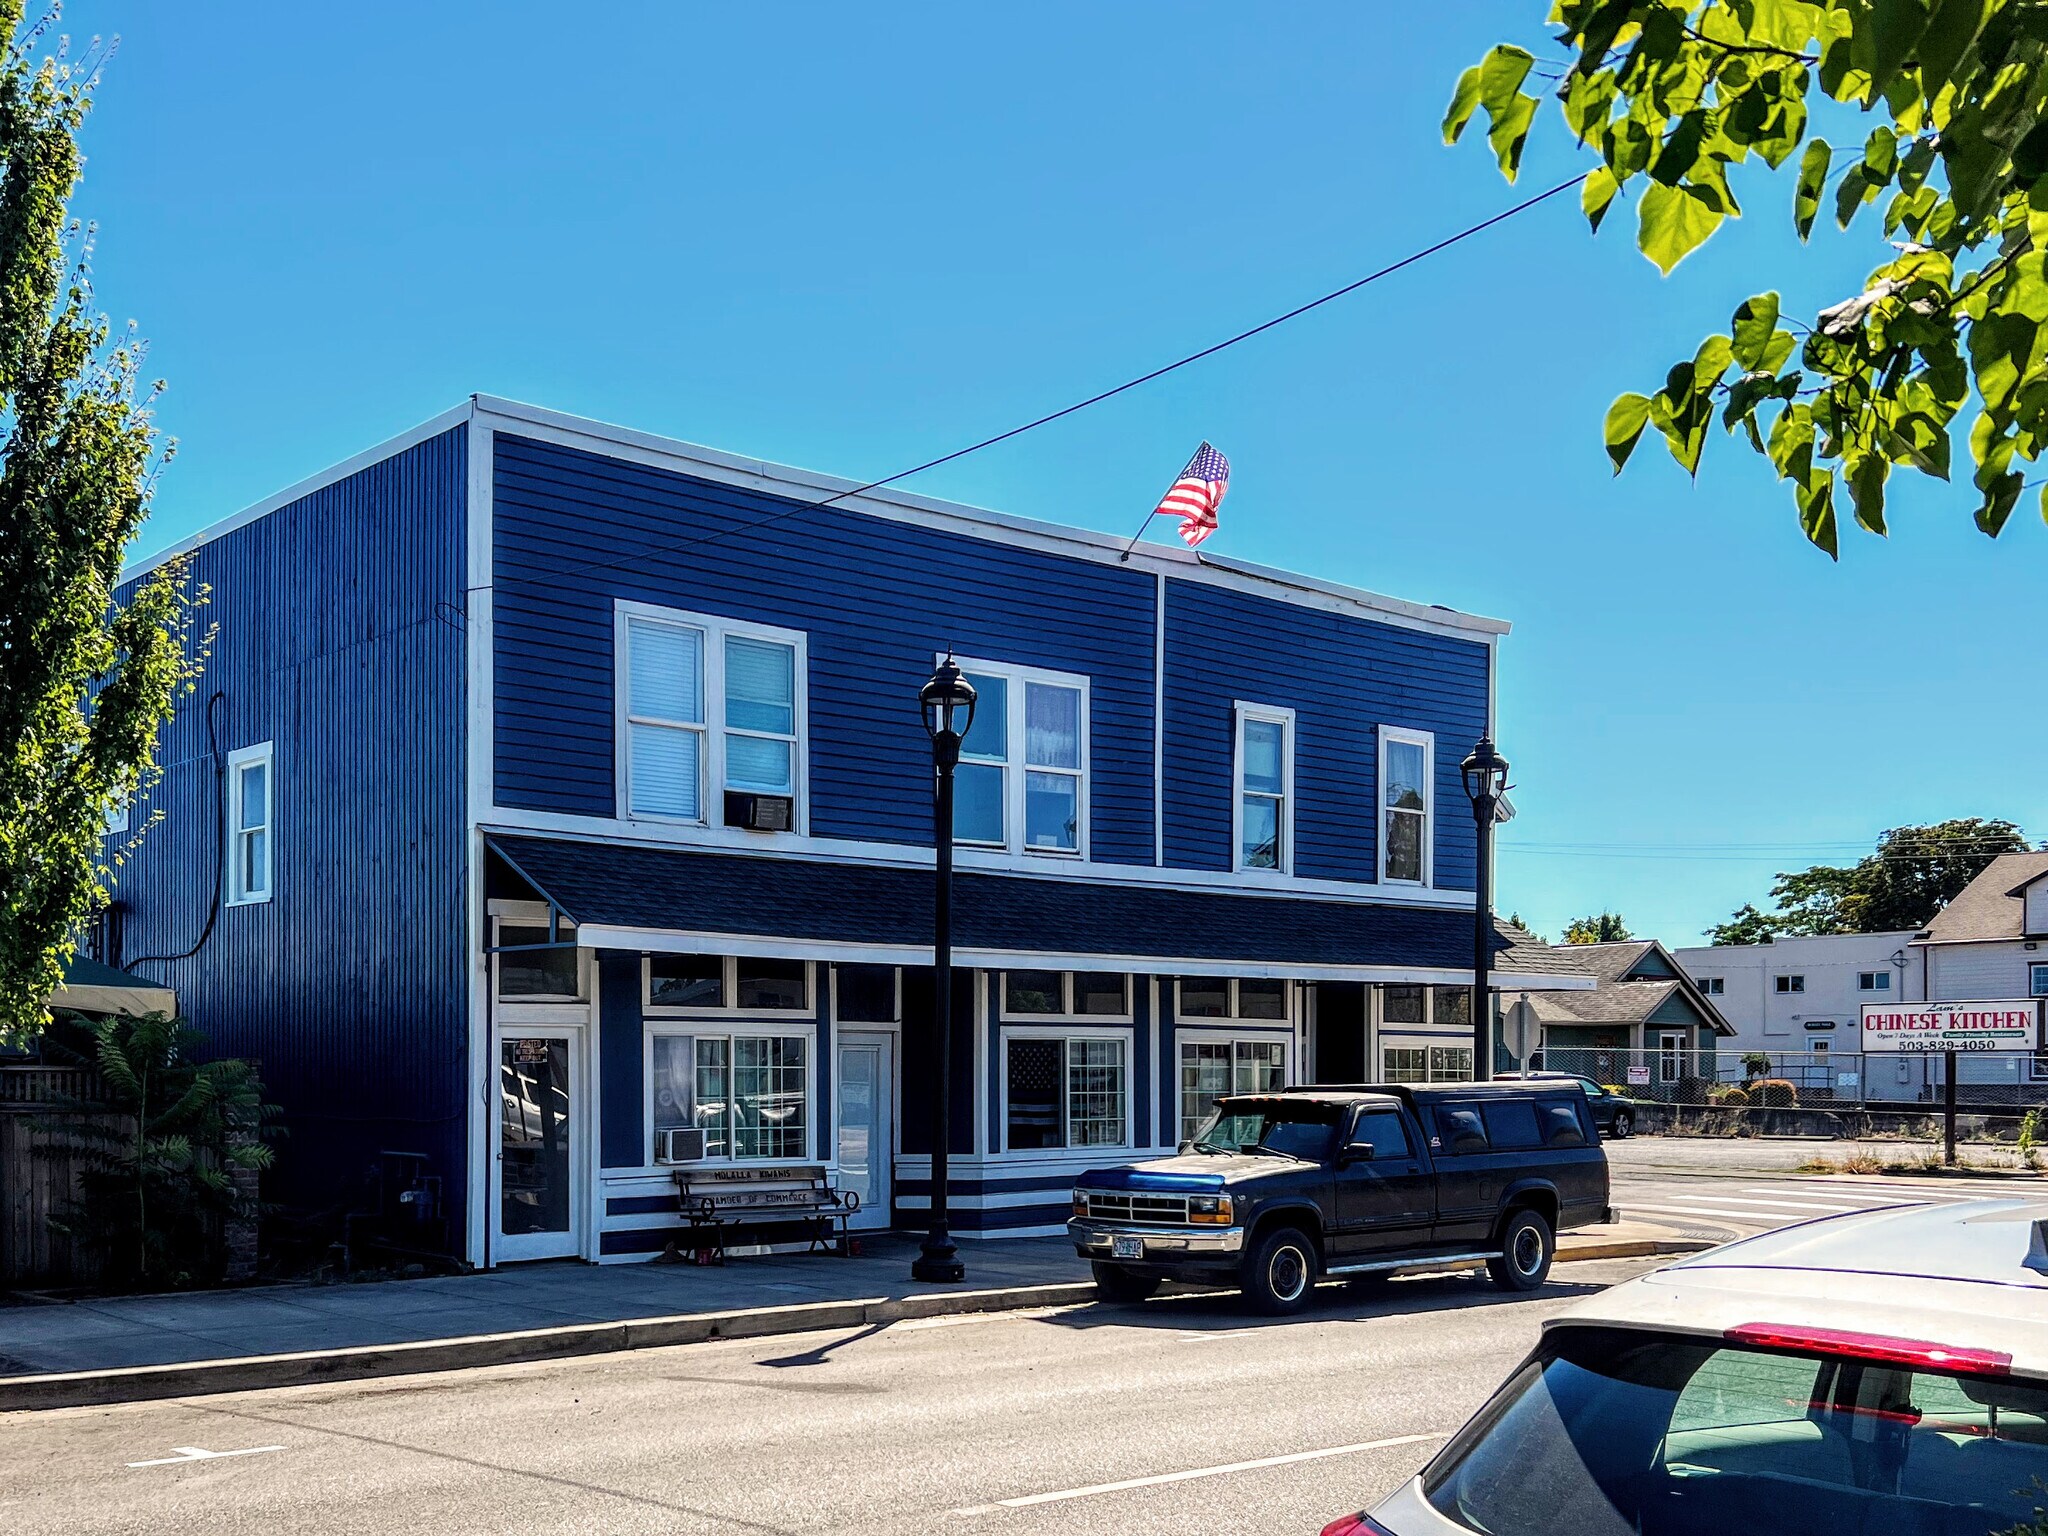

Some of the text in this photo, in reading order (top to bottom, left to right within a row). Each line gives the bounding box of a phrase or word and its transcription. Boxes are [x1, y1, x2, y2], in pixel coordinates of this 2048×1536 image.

[1926, 1003, 1964, 1012] Lam's
[1865, 1011, 2031, 1030] CHINESE KITCHEN
[1898, 1041, 1995, 1050] 503-829-4050
[714, 1169, 791, 1180] MOLALLA KIWANIS
[748, 1195, 758, 1203] OF
[765, 1193, 807, 1203] COMMERCE
